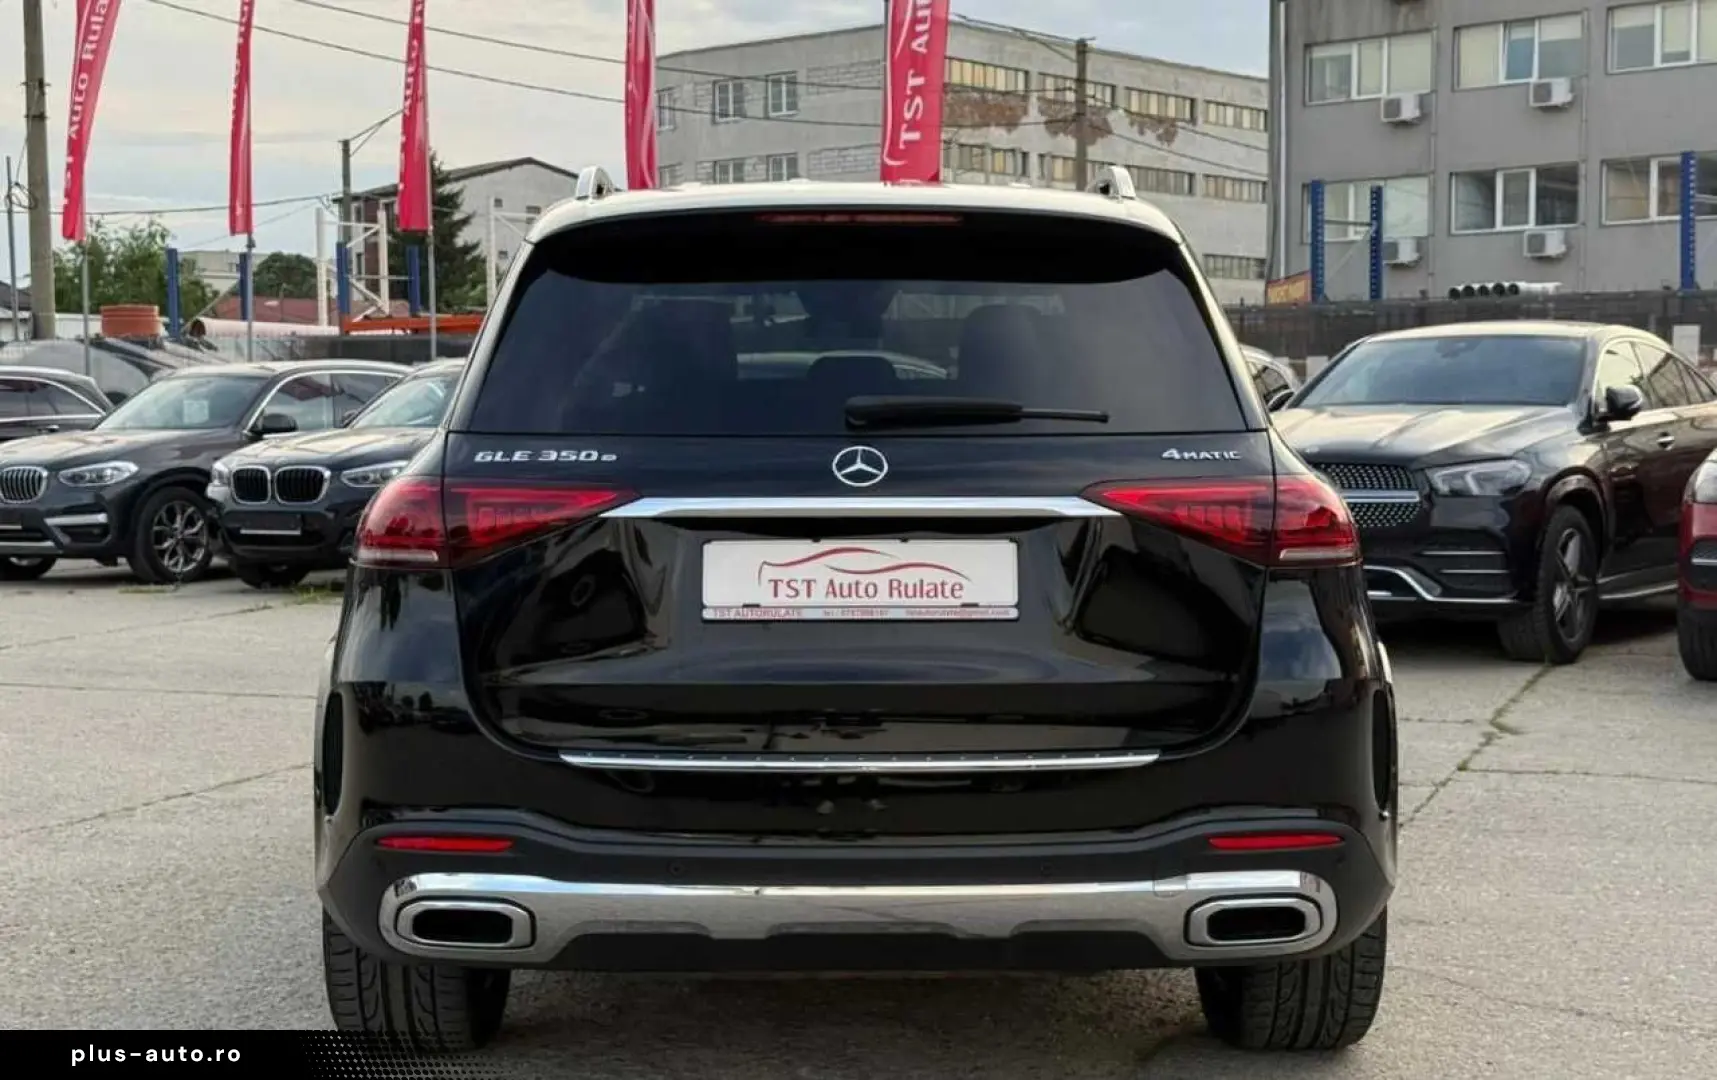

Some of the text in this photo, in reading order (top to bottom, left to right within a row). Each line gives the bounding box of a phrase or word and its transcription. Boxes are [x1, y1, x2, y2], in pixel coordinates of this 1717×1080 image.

[899, 69, 926, 150] TST
[474, 450, 534, 462] GLE
[1161, 447, 1243, 460] 4MATIC
[767, 578, 964, 599] TST Auto Rulate
